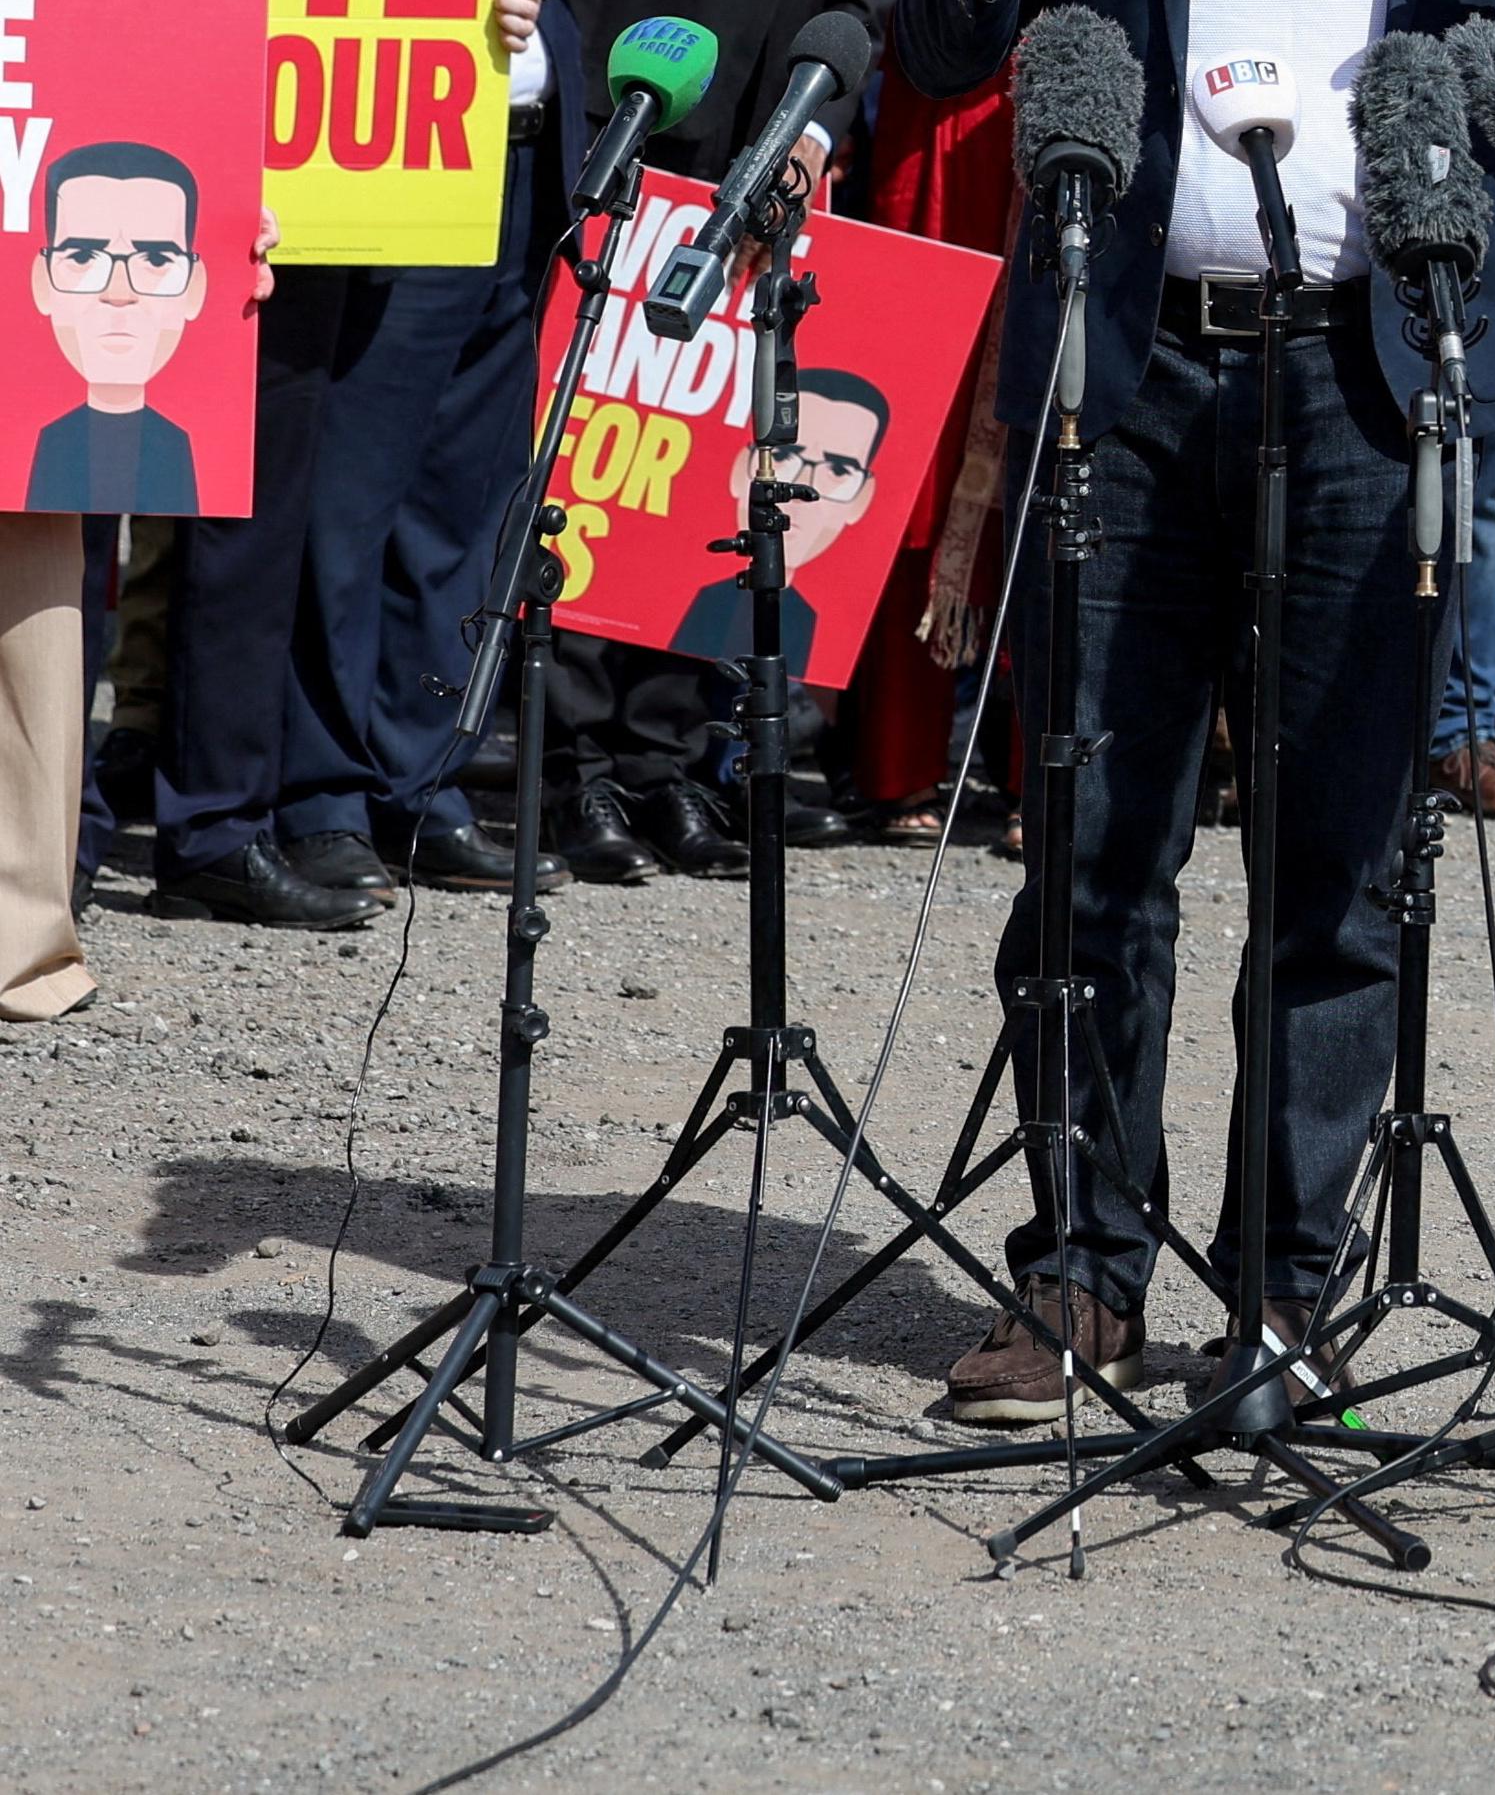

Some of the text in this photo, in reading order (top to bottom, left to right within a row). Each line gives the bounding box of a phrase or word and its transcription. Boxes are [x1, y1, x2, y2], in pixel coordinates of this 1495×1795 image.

[265, 34, 477, 171] OUR
[1209, 61, 1278, 94] LBC
[540, 503, 610, 603] S
